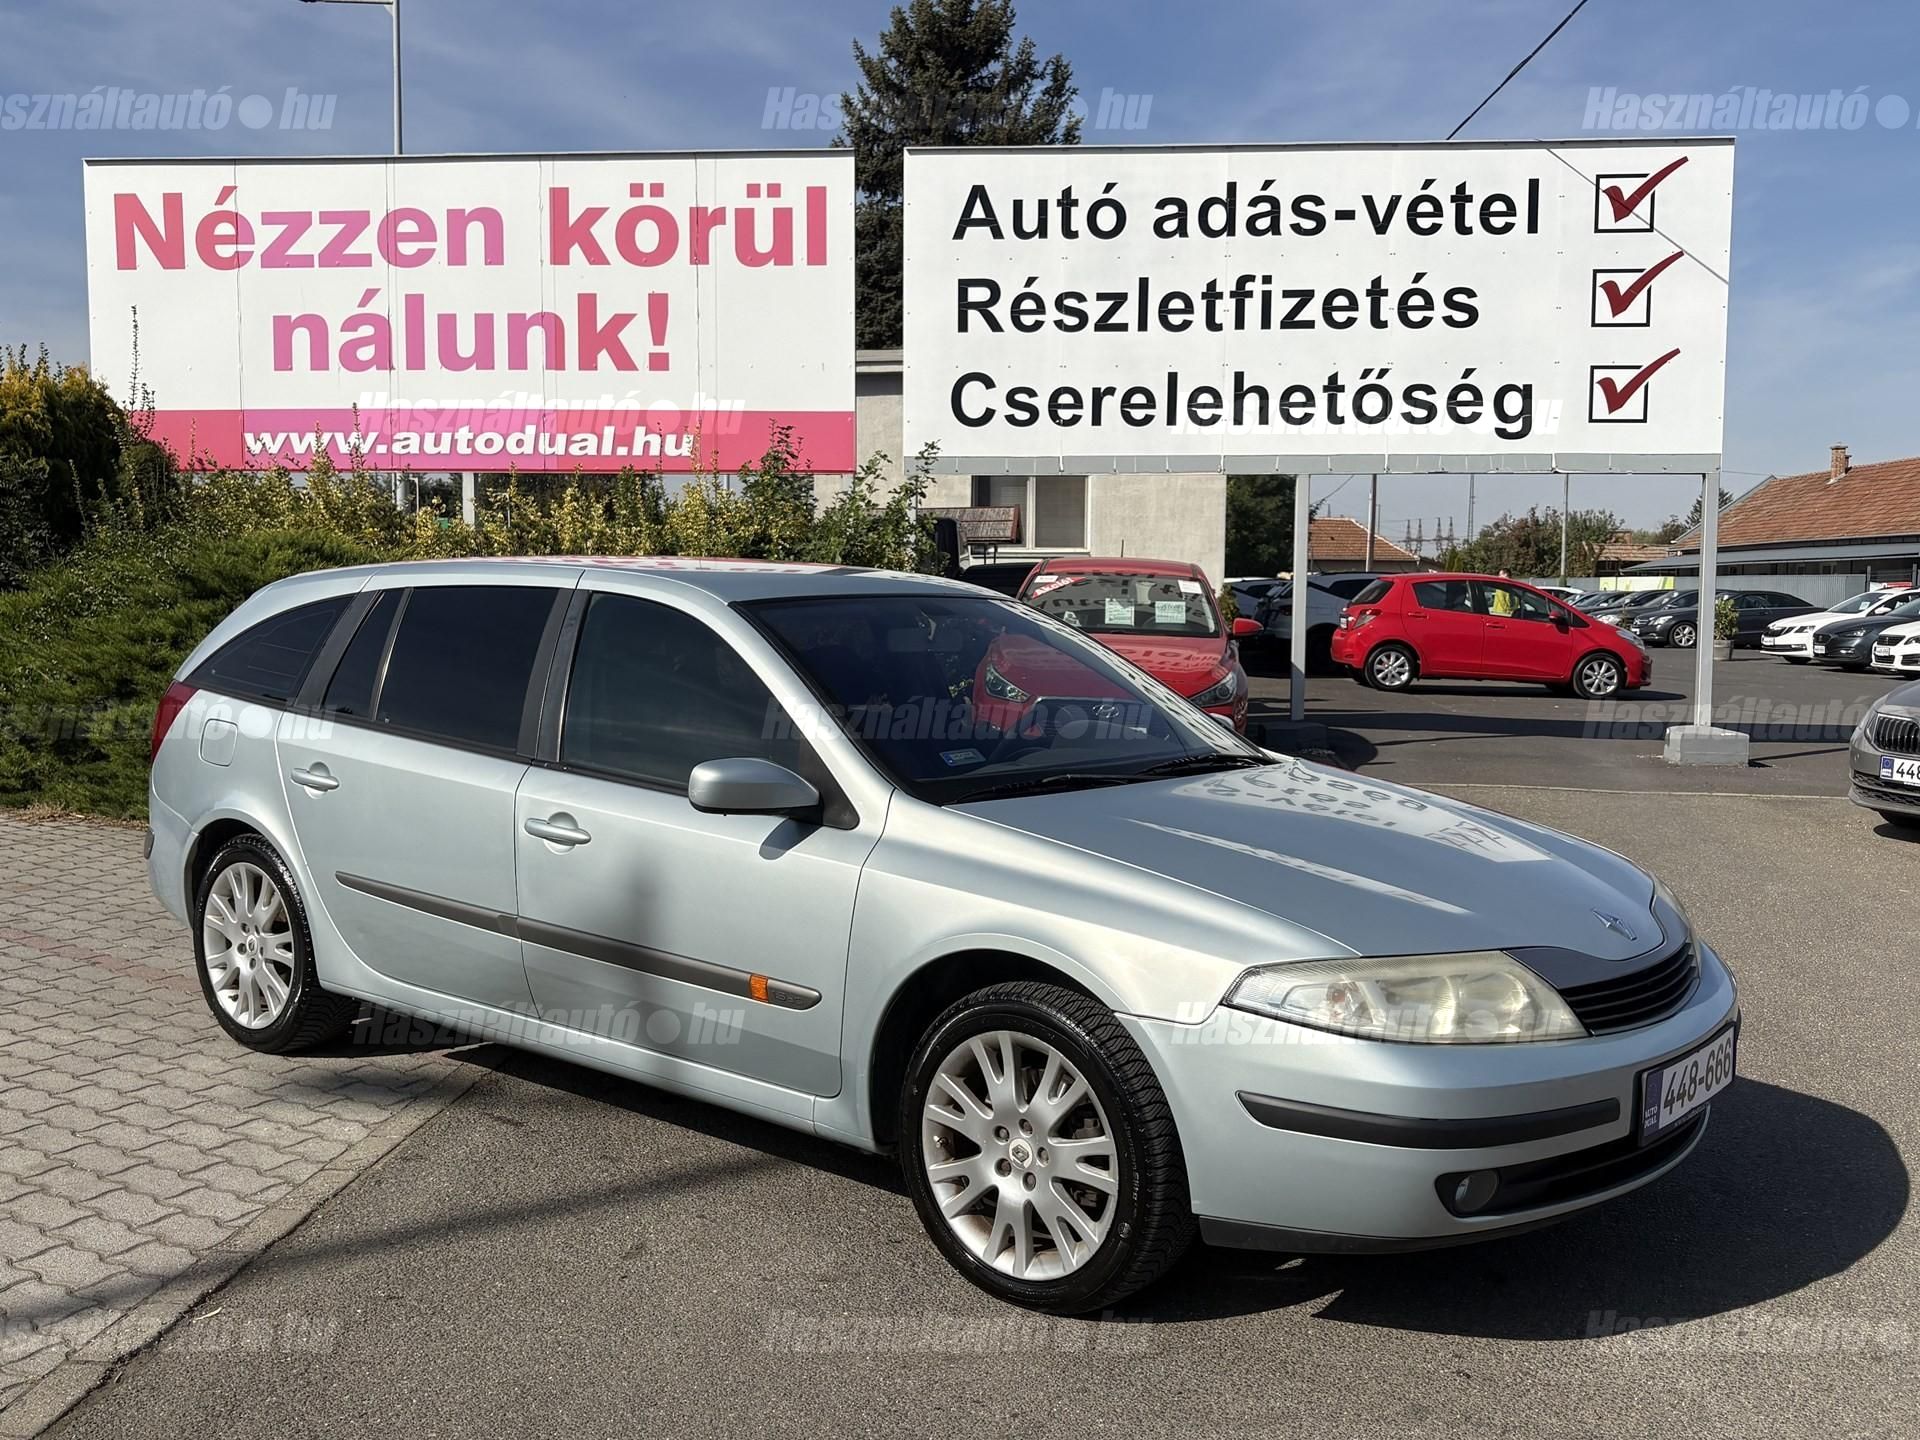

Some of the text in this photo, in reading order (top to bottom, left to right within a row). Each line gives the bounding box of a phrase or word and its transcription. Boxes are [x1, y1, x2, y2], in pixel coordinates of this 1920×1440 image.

[114, 183, 827, 270] Nézzen körül
[952, 178, 1540, 241] Autó adás-vétel
[273, 289, 669, 372] nálunk!
[957, 271, 1479, 333] Részletfizetés
[950, 367, 1533, 440] Cserelehetőség
[244, 424, 695, 458] www.autodual.hu
[1663, 1036, 1732, 1115] 448-666
